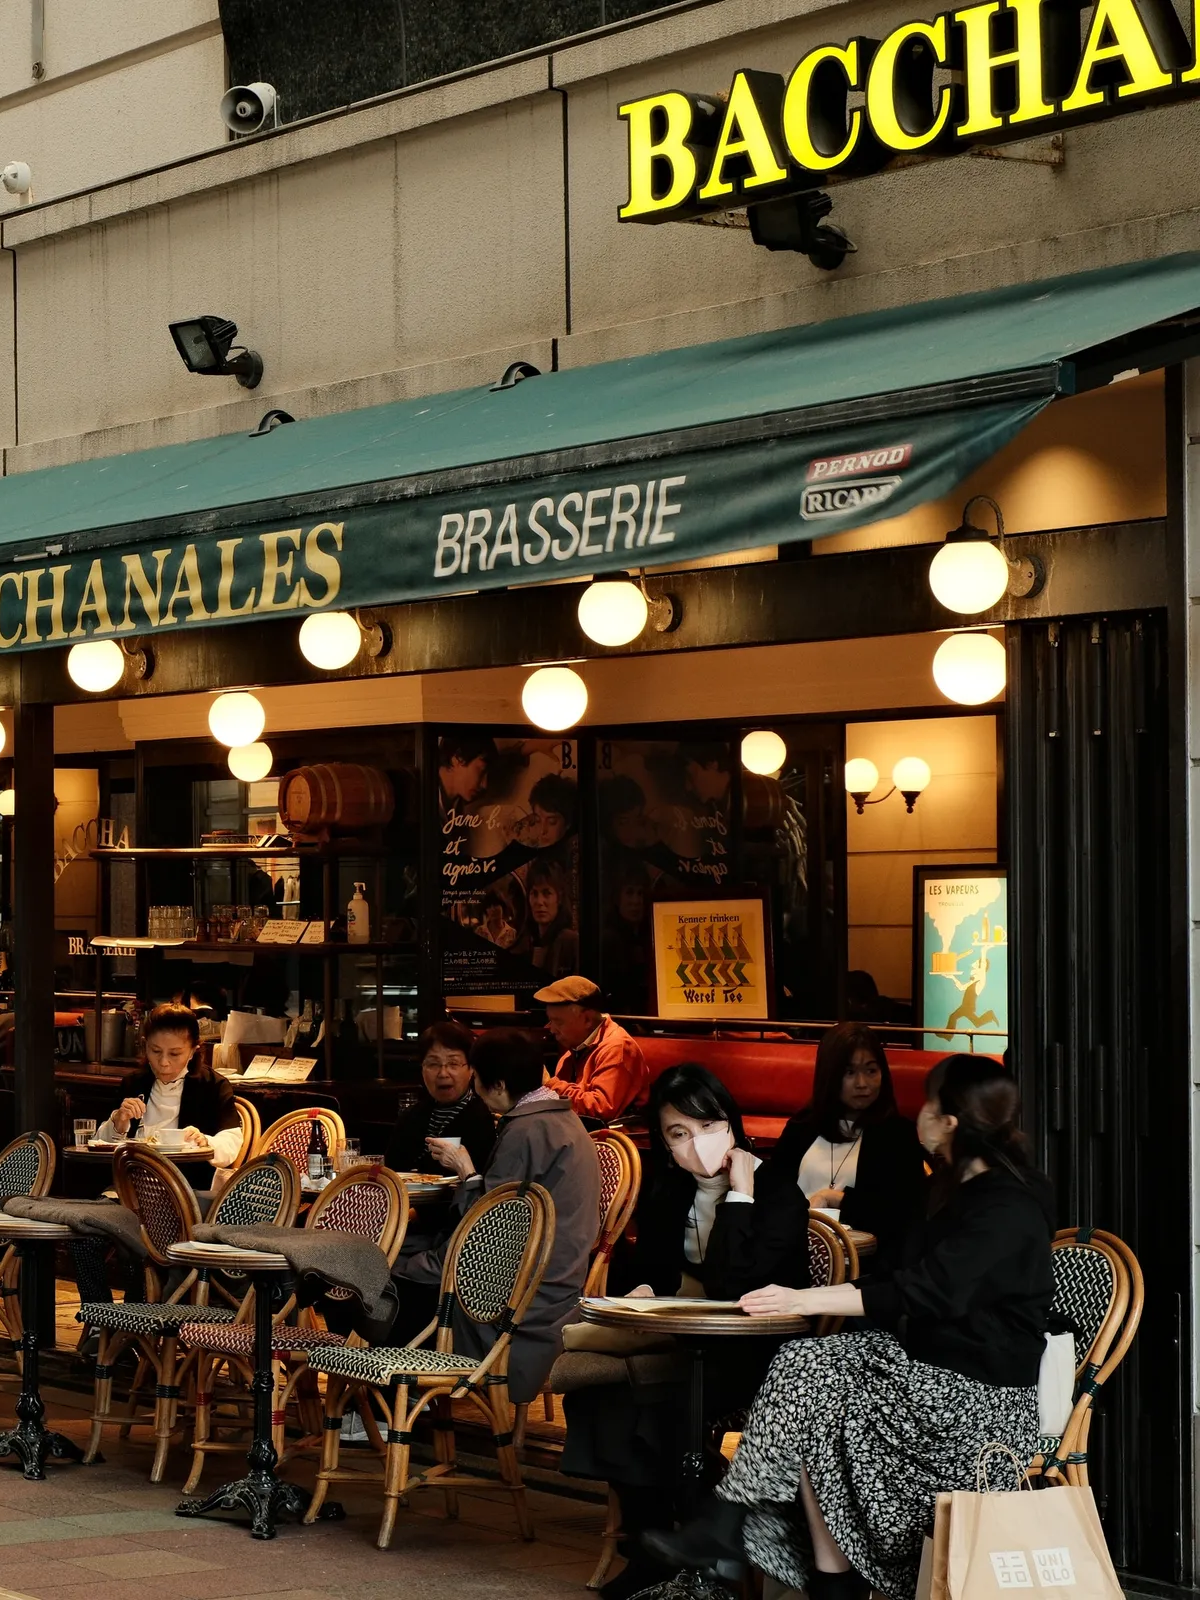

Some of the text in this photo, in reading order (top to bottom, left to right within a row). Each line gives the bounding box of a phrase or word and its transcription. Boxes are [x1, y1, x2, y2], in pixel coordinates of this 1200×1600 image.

[618, 0, 1200, 219] BACCHA
[811, 447, 905, 479] PERNOD
[433, 475, 687, 578] BRASSERIE
[562, 741, 576, 769] B.
[442, 808, 482, 834] Jane
[443, 836, 467, 856] et
[442, 857, 481, 886] agnès
[929, 884, 979, 896] LES VAPEURS
[678, 913, 740, 924] Kenner trinken
[723, 987, 743, 1003] Tee
[1037, 1552, 1064, 1567] UNI
[1042, 1568, 1070, 1583] QLO
